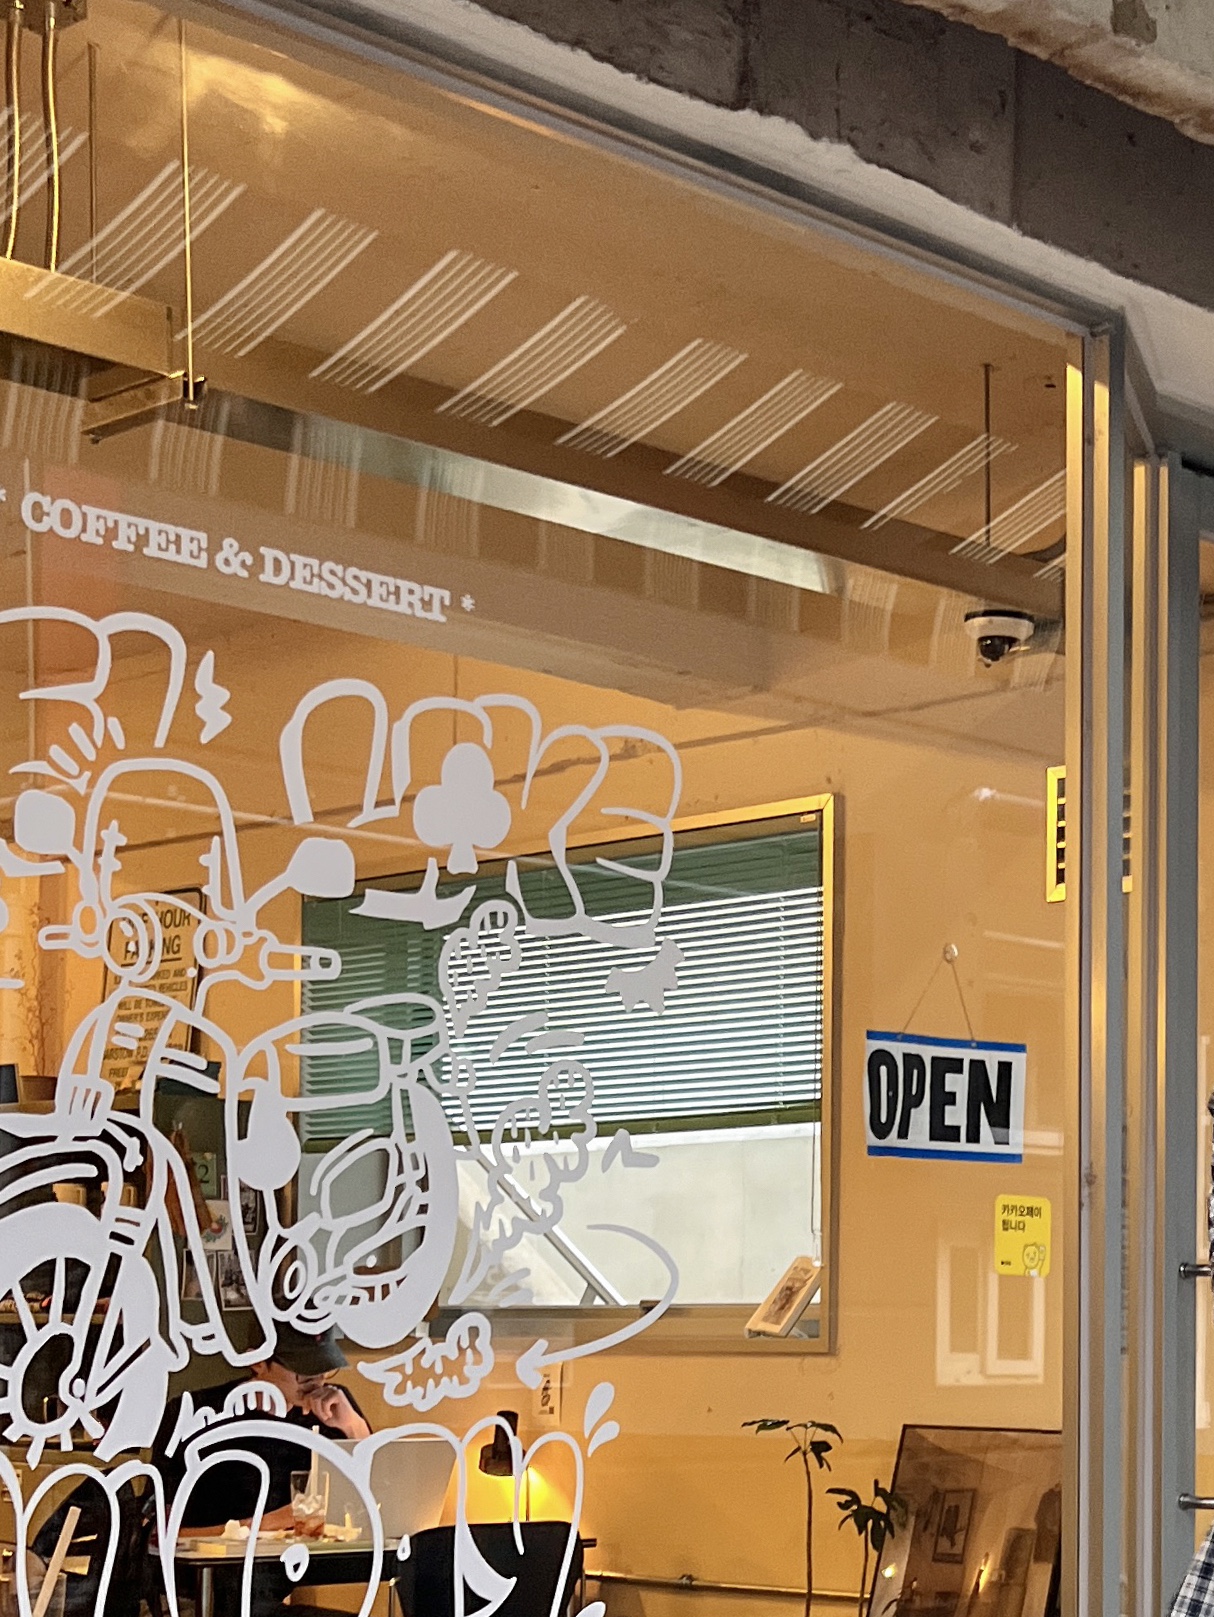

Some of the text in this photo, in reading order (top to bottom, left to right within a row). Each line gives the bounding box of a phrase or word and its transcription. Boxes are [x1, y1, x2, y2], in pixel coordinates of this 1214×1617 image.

[20, 491, 451, 623] COFFEE & DESSERT
[866, 1047, 1013, 1146] OPEN
